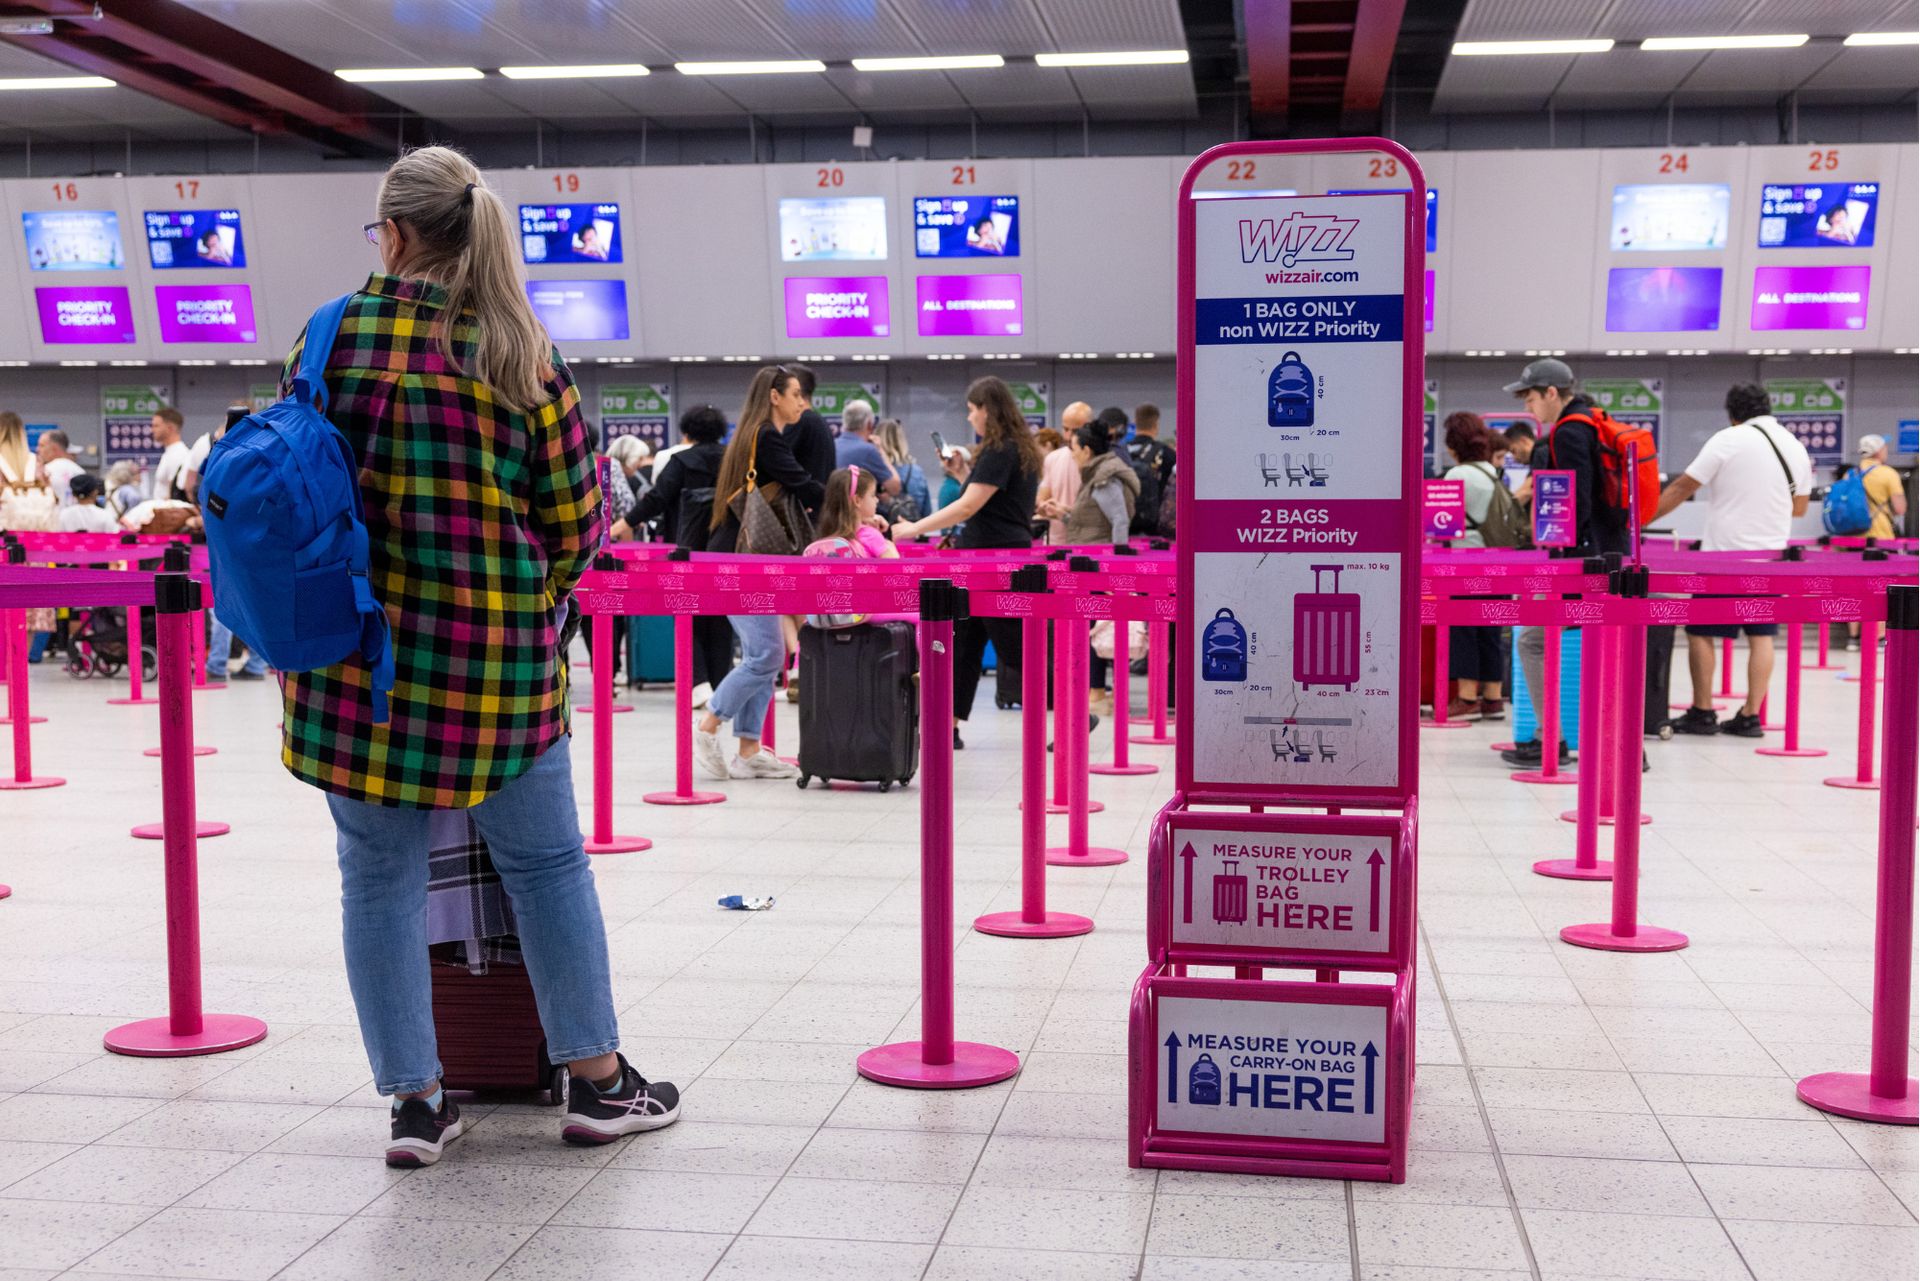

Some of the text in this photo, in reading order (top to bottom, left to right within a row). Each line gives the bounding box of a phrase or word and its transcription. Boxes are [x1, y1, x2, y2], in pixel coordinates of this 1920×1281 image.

[1369, 159, 1397, 178] 23
[1659, 154, 1688, 173] 24
[1809, 151, 1839, 170] 25
[817, 169, 844, 187] 20
[952, 166, 976, 185] 21
[1227, 161, 1256, 180] 22
[53, 183, 78, 201] 16
[175, 181, 200, 199] 17
[553, 174, 579, 192] 19
[1265, 269, 1359, 284] wizzair.com
[56, 301, 112, 314] PRIORITY
[176, 300, 233, 313] PRIORITY
[806, 293, 867, 306] PRIORITY
[923, 300, 943, 311] ALL
[1757, 293, 1780, 304] ALL
[177, 312, 236, 324] CHECK-IN
[806, 305, 869, 318] CHECK-IN
[1243, 301, 1357, 318] 1 BAG ONLY
[58, 313, 116, 326] CHECK-IN
[1220, 320, 1380, 339] non WIZZ Priority
[1317, 375, 1324, 399] 40 cm
[1260, 508, 1329, 524] 2 BAGS
[1237, 527, 1358, 546] WIZZ Priority
[1379, 563, 1390, 571] kg
[1250, 632, 1257, 655] 40 cm
[1365, 631, 1371, 653] 55 cm
[1213, 844, 1352, 862] MEASURE YOUR
[1256, 866, 1350, 884] TROLLEY
[1256, 885, 1299, 901] BAG
[1257, 903, 1353, 931] HERE
[1188, 1034, 1356, 1057] MEASURE YOUR
[1230, 1055, 1355, 1074] CARRY-ON BAG
[1229, 1073, 1355, 1114] HERE
